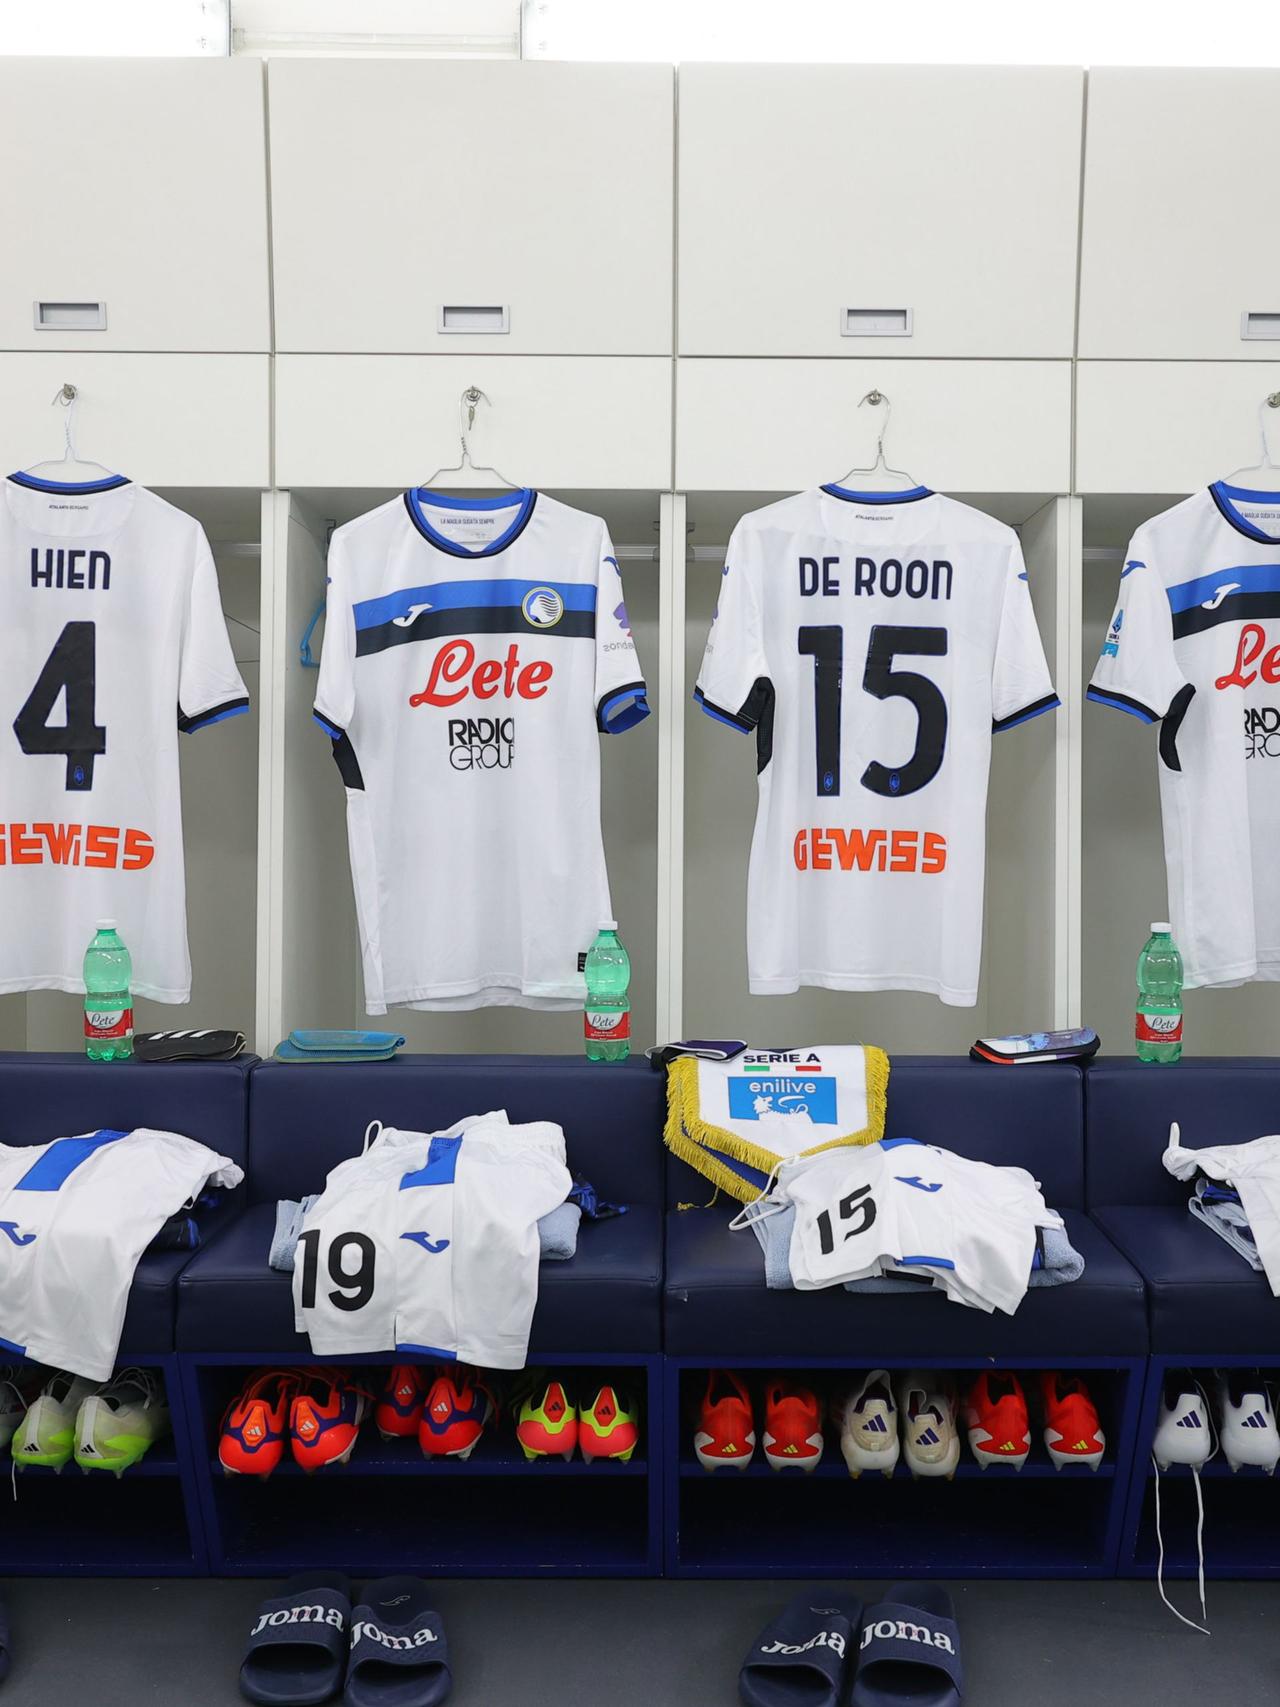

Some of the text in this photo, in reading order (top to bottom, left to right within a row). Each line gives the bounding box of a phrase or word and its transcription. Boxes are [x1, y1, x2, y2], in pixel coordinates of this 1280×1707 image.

[31, 547, 111, 590] HIEN
[798, 556, 953, 600] DE ROON
[13, 620, 107, 791] 4
[409, 639, 553, 708] Lete
[798, 625, 948, 798] 15
[743, 1053, 822, 1064] SERIE A
[749, 1078, 817, 1094] enilive
[816, 1184, 877, 1255] 15
[297, 1228, 376, 1312] 19
